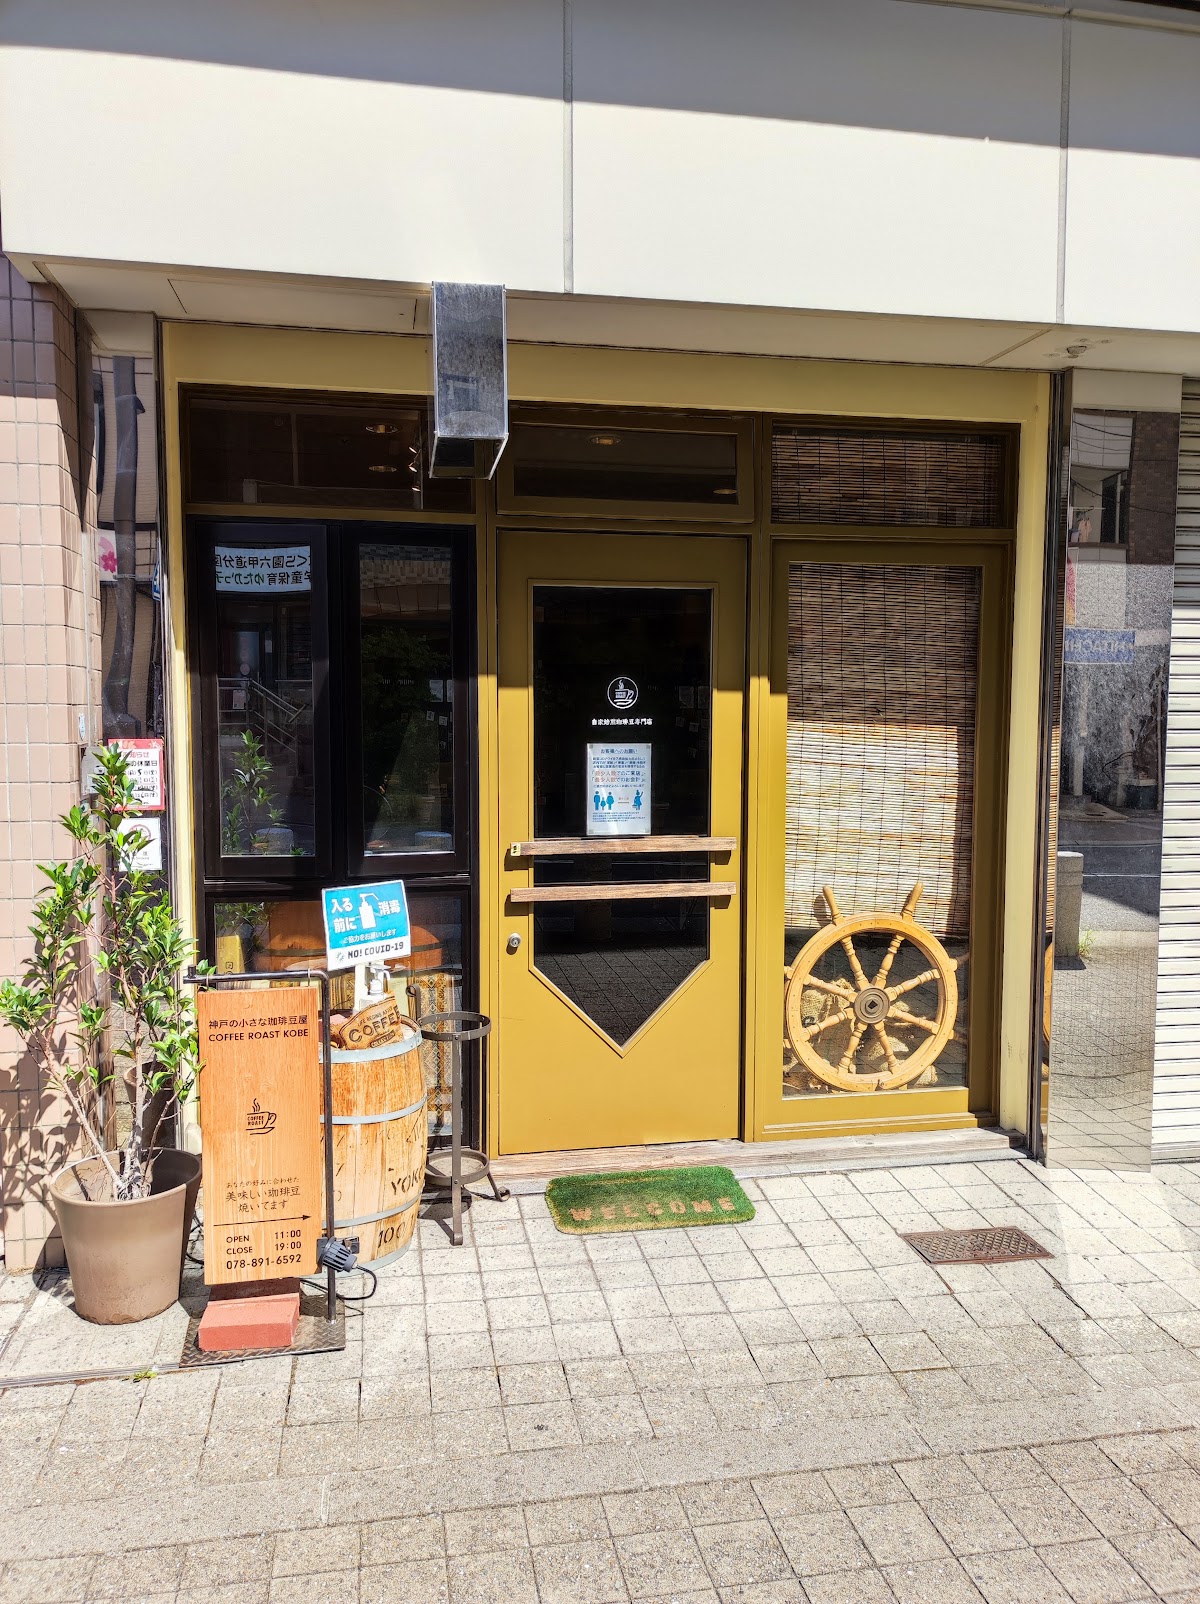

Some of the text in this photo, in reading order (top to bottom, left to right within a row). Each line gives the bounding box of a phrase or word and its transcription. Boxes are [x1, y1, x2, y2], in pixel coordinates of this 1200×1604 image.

[332, 898, 353, 914] 入る
[378, 900, 400, 915] 消毒
[334, 916, 357, 934] 前に
[343, 928, 396, 944] ご協力をお願いします
[348, 942, 404, 959] NO! COVID-19
[209, 1015, 308, 1029] 神戸の小さな珈琲豆屋
[209, 1029, 308, 1041] COFFEE ROAST KOBE
[227, 1177, 300, 1188] あなたの好みに合わせた
[226, 1186, 300, 1202] 美味しい珈琲豆
[239, 1200, 288, 1213] 焼いてます
[568, 1196, 735, 1221] WELCOME
[226, 1230, 301, 1244] OPEN 11:00
[226, 1241, 301, 1255] CLOSE 19:00
[226, 1254, 301, 1270] 078-891-6592
